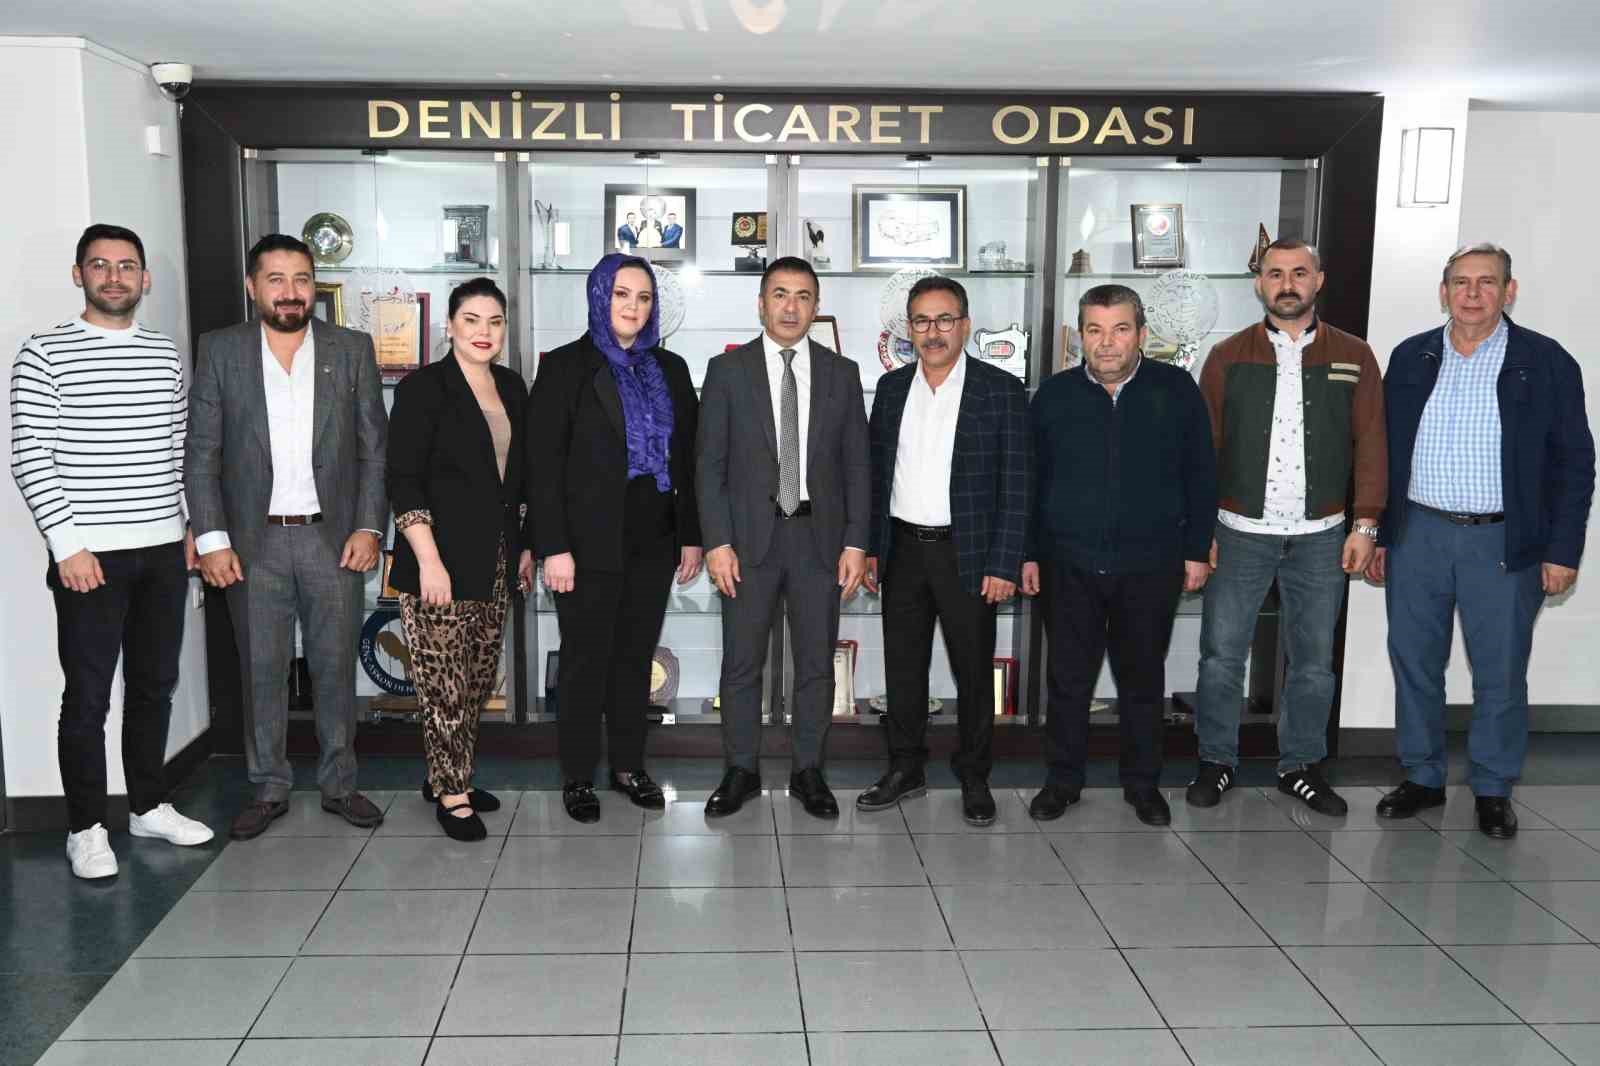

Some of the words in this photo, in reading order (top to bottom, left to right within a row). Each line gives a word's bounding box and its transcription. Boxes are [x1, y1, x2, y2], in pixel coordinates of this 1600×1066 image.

[367, 91, 621, 140] DENİZLİ
[671, 93, 944, 144] TİCARET
[991, 105, 1195, 145] ODASI
